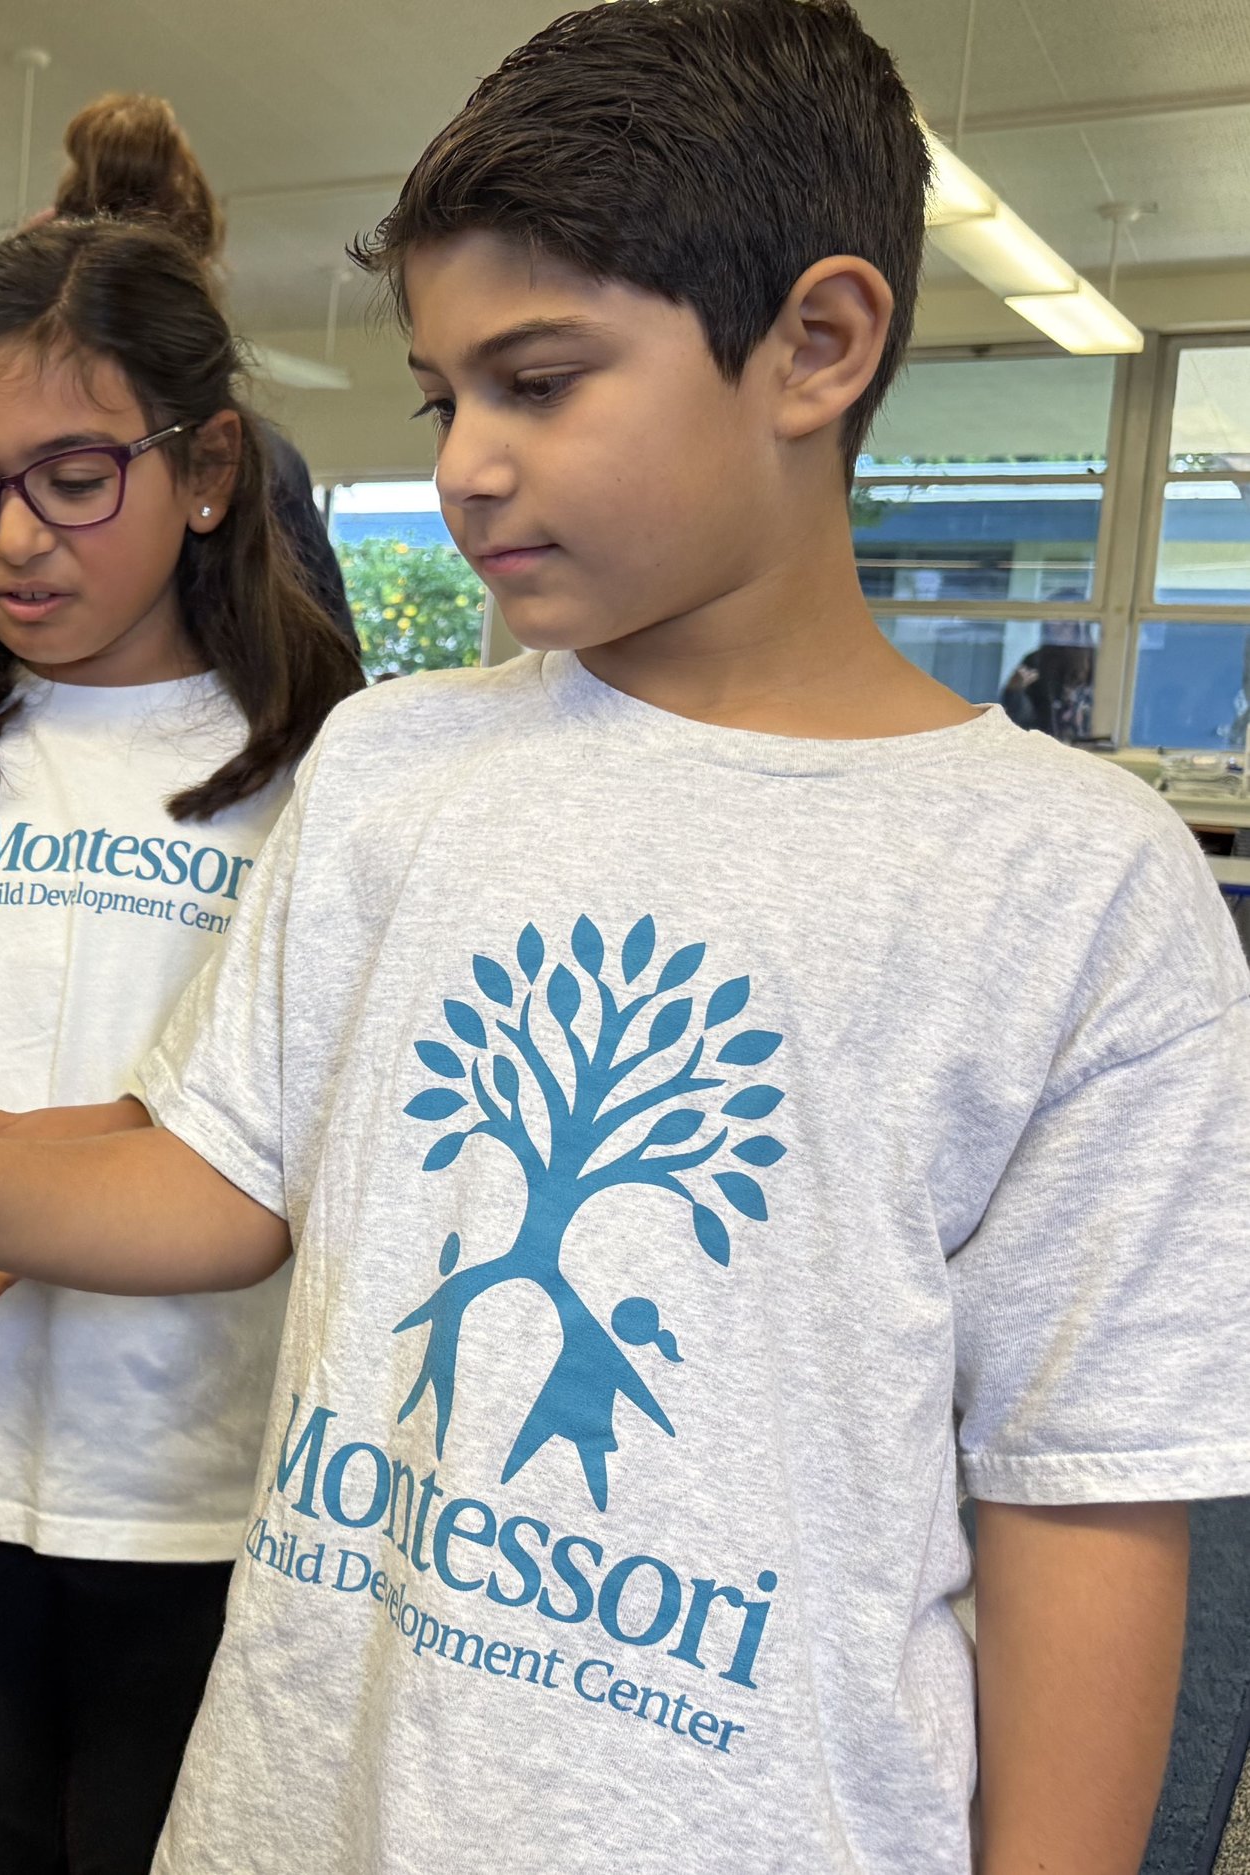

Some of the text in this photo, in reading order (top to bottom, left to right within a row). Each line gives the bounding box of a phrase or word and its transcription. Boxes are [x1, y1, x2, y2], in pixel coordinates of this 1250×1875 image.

[246, 1518, 745, 1754] Child Development Center
[268, 1392, 778, 1690] Montessori
